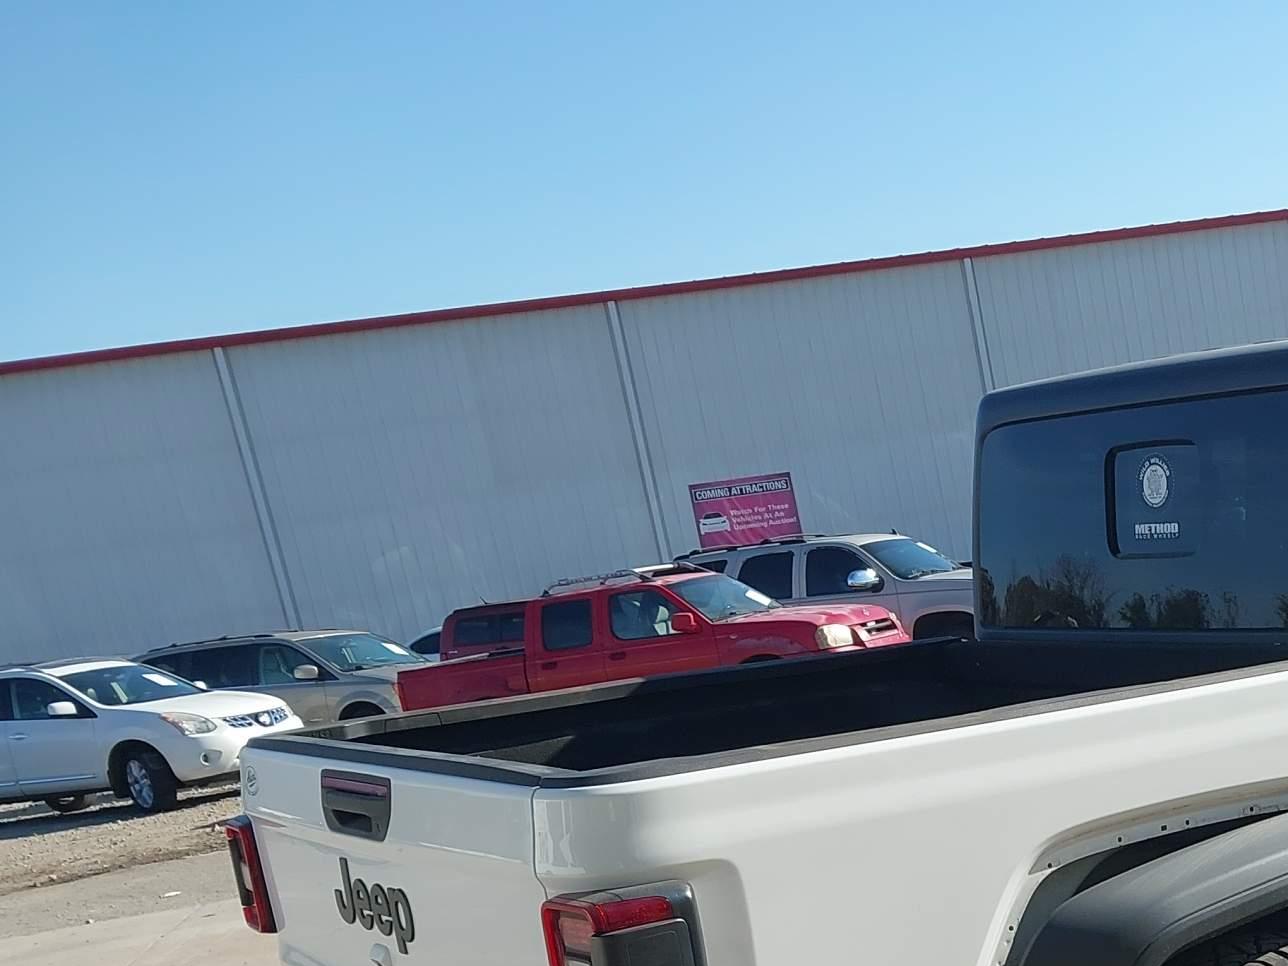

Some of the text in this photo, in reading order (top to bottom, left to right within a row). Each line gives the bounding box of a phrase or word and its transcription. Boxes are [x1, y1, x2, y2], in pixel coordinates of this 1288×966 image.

[696, 480, 787, 500] COMING ATTRACTIONS
[1135, 523, 1179, 534] METHOD
[334, 857, 415, 955] Jeep
